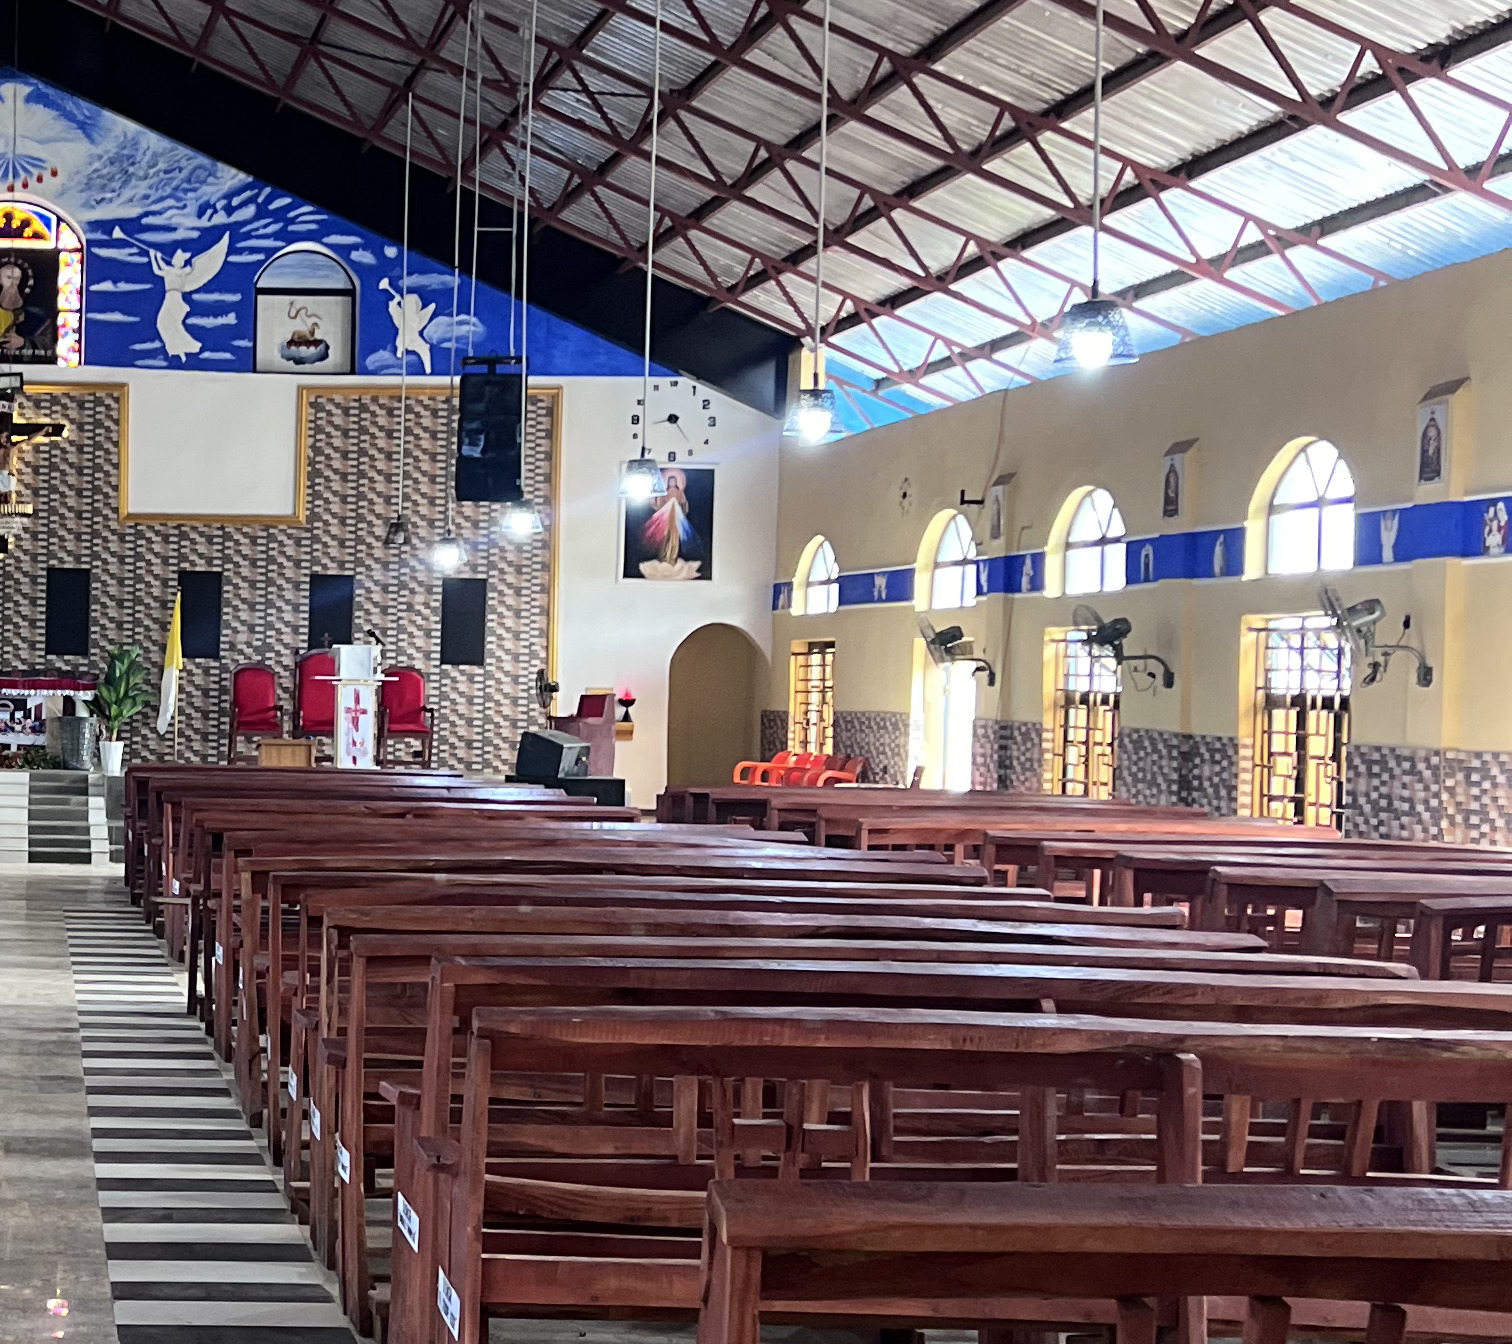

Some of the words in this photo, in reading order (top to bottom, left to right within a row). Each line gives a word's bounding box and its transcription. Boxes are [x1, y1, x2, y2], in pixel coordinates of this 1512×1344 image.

[692, 385, 696, 396] 1
[702, 399, 710, 410] 2
[708, 416, 716, 427] 3
